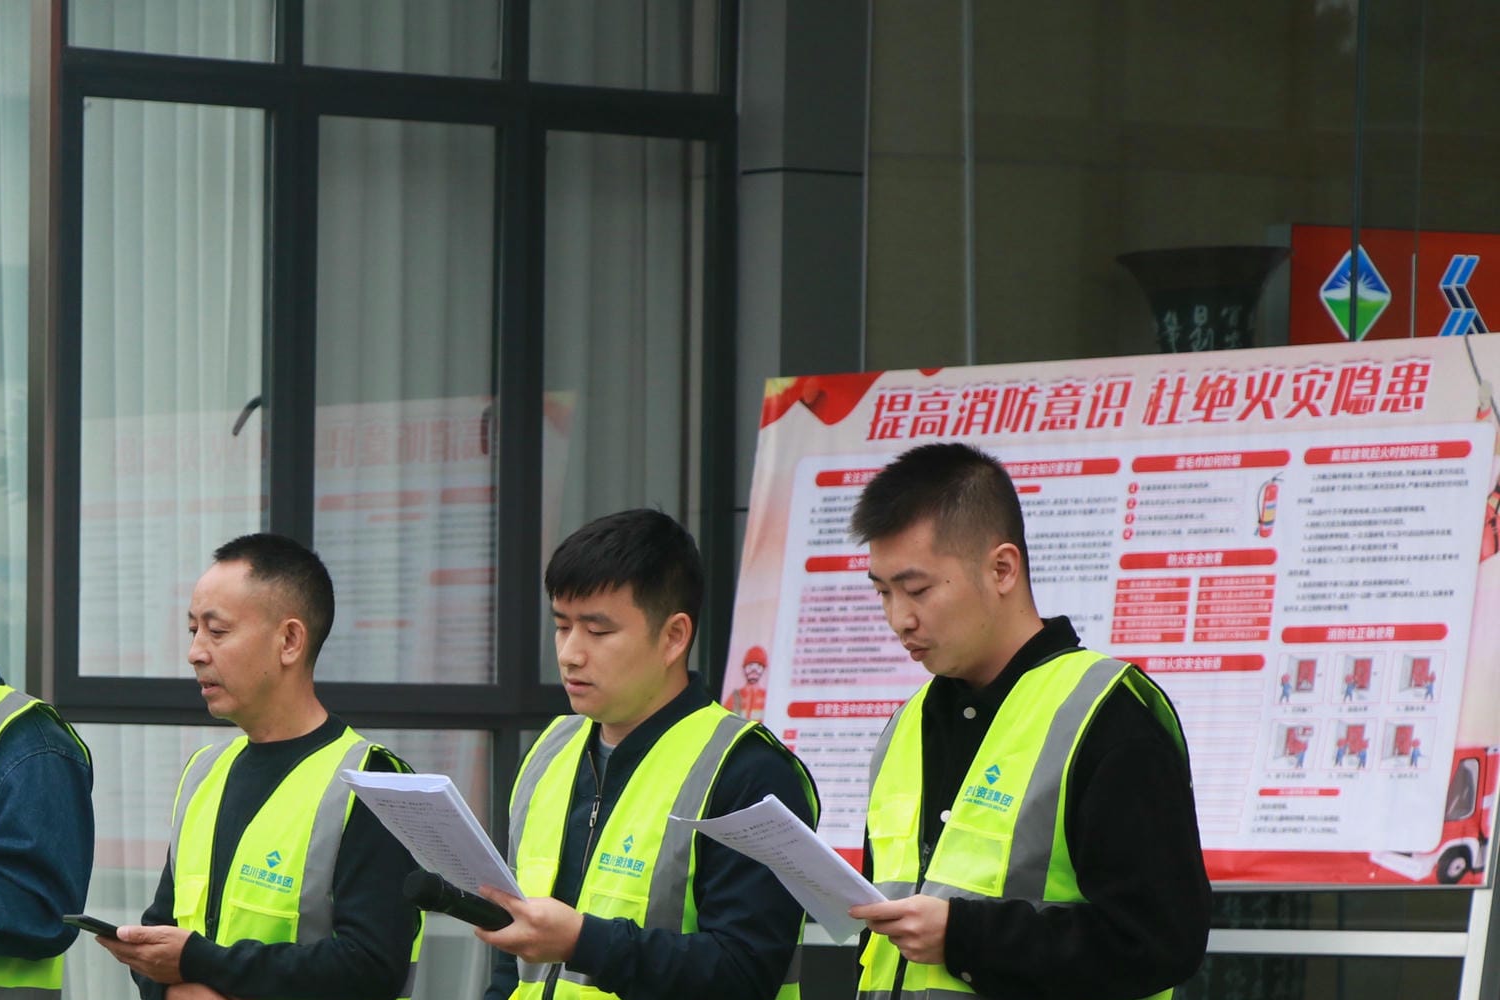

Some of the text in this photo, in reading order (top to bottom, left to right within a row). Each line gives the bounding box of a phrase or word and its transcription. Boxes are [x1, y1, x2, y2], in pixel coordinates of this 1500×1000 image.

[866, 362, 1431, 441] 提高消防意识 杜绝火灾隐患
[1167, 552, 1224, 567] 防火安全教育
